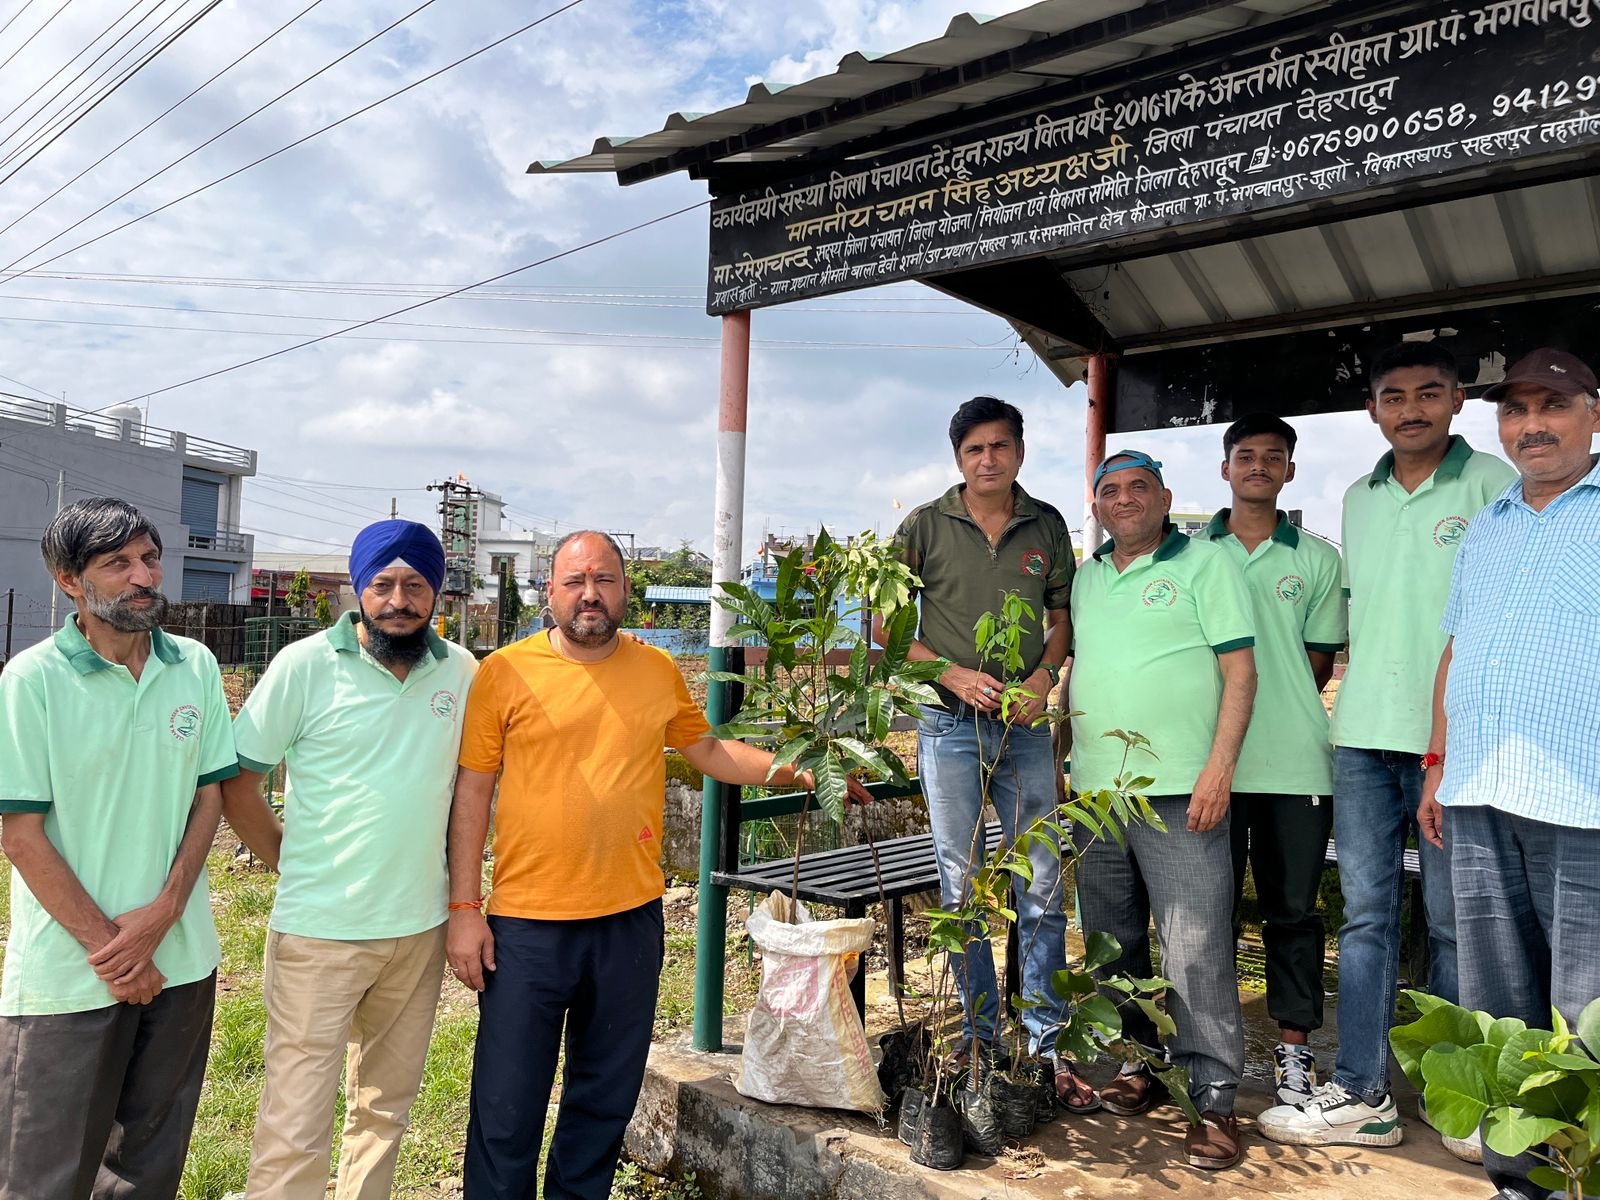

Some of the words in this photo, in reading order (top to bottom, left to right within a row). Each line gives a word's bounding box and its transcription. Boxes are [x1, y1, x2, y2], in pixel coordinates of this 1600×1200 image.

[712, 186, 780, 229] कार्यदायी
[779, 183, 827, 216] संस्था
[828, 171, 870, 202] जिला
[871, 162, 933, 192] पंचायत
[1208, 47, 1304, 105] अन्तर्गत
[1304, 31, 1398, 80] स्वीकृत
[1468, 0, 1600, 35] भगवानपु
[785, 202, 874, 242] माननीय
[875, 188, 939, 222] चमन
[941, 177, 994, 207] सिंह
[995, 152, 1092, 196] अध्यक्ष
[1143, 126, 1200, 157] जिला
[1204, 102, 1292, 140] पंचायत
[1296, 76, 1400, 122] देहरादून
[844, 233, 869, 257] जिला
[1027, 191, 1048, 217] एवं
[1048, 187, 1090, 214] विकास
[1089, 170, 1134, 204] समिति
[1135, 165, 1179, 194] जिला
[1178, 152, 1248, 189] देहरादून
[1492, 75, 1600, 117] 94129
[770, 280, 790, 296] ग्राम
[819, 261, 850, 287] श्रीमती
[877, 251, 899, 274] देवी
[1130, 199, 1150, 224] की
[1150, 197, 1192, 219] जनता
[1461, 124, 1539, 156] सहसपुर
